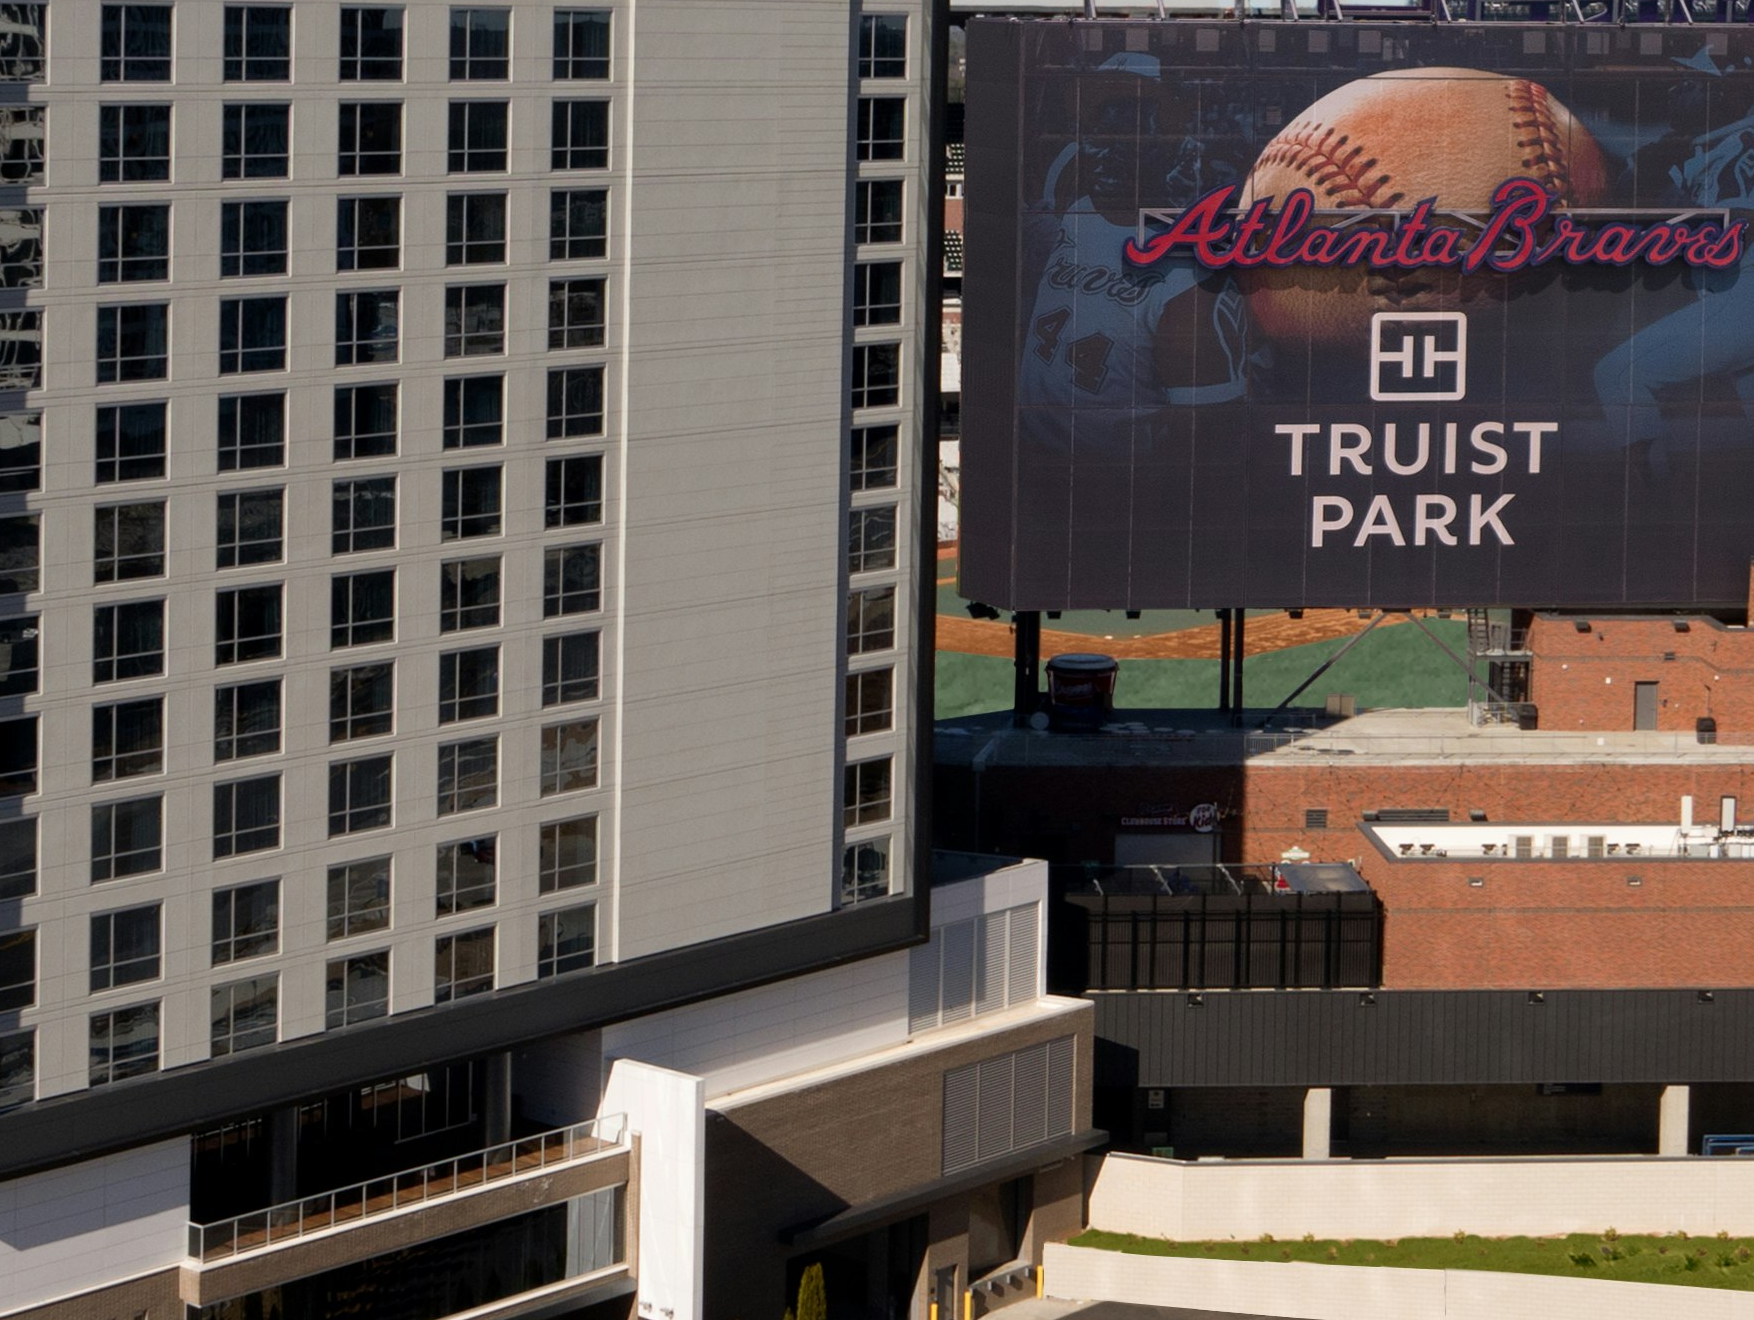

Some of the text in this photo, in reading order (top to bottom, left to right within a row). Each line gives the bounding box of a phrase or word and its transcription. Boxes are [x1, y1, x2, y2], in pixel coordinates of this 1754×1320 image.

[1125, 176, 1749, 275] Atlanta Braves
[1274, 421, 1558, 476] TRUIST
[1311, 493, 1517, 548] PARK
